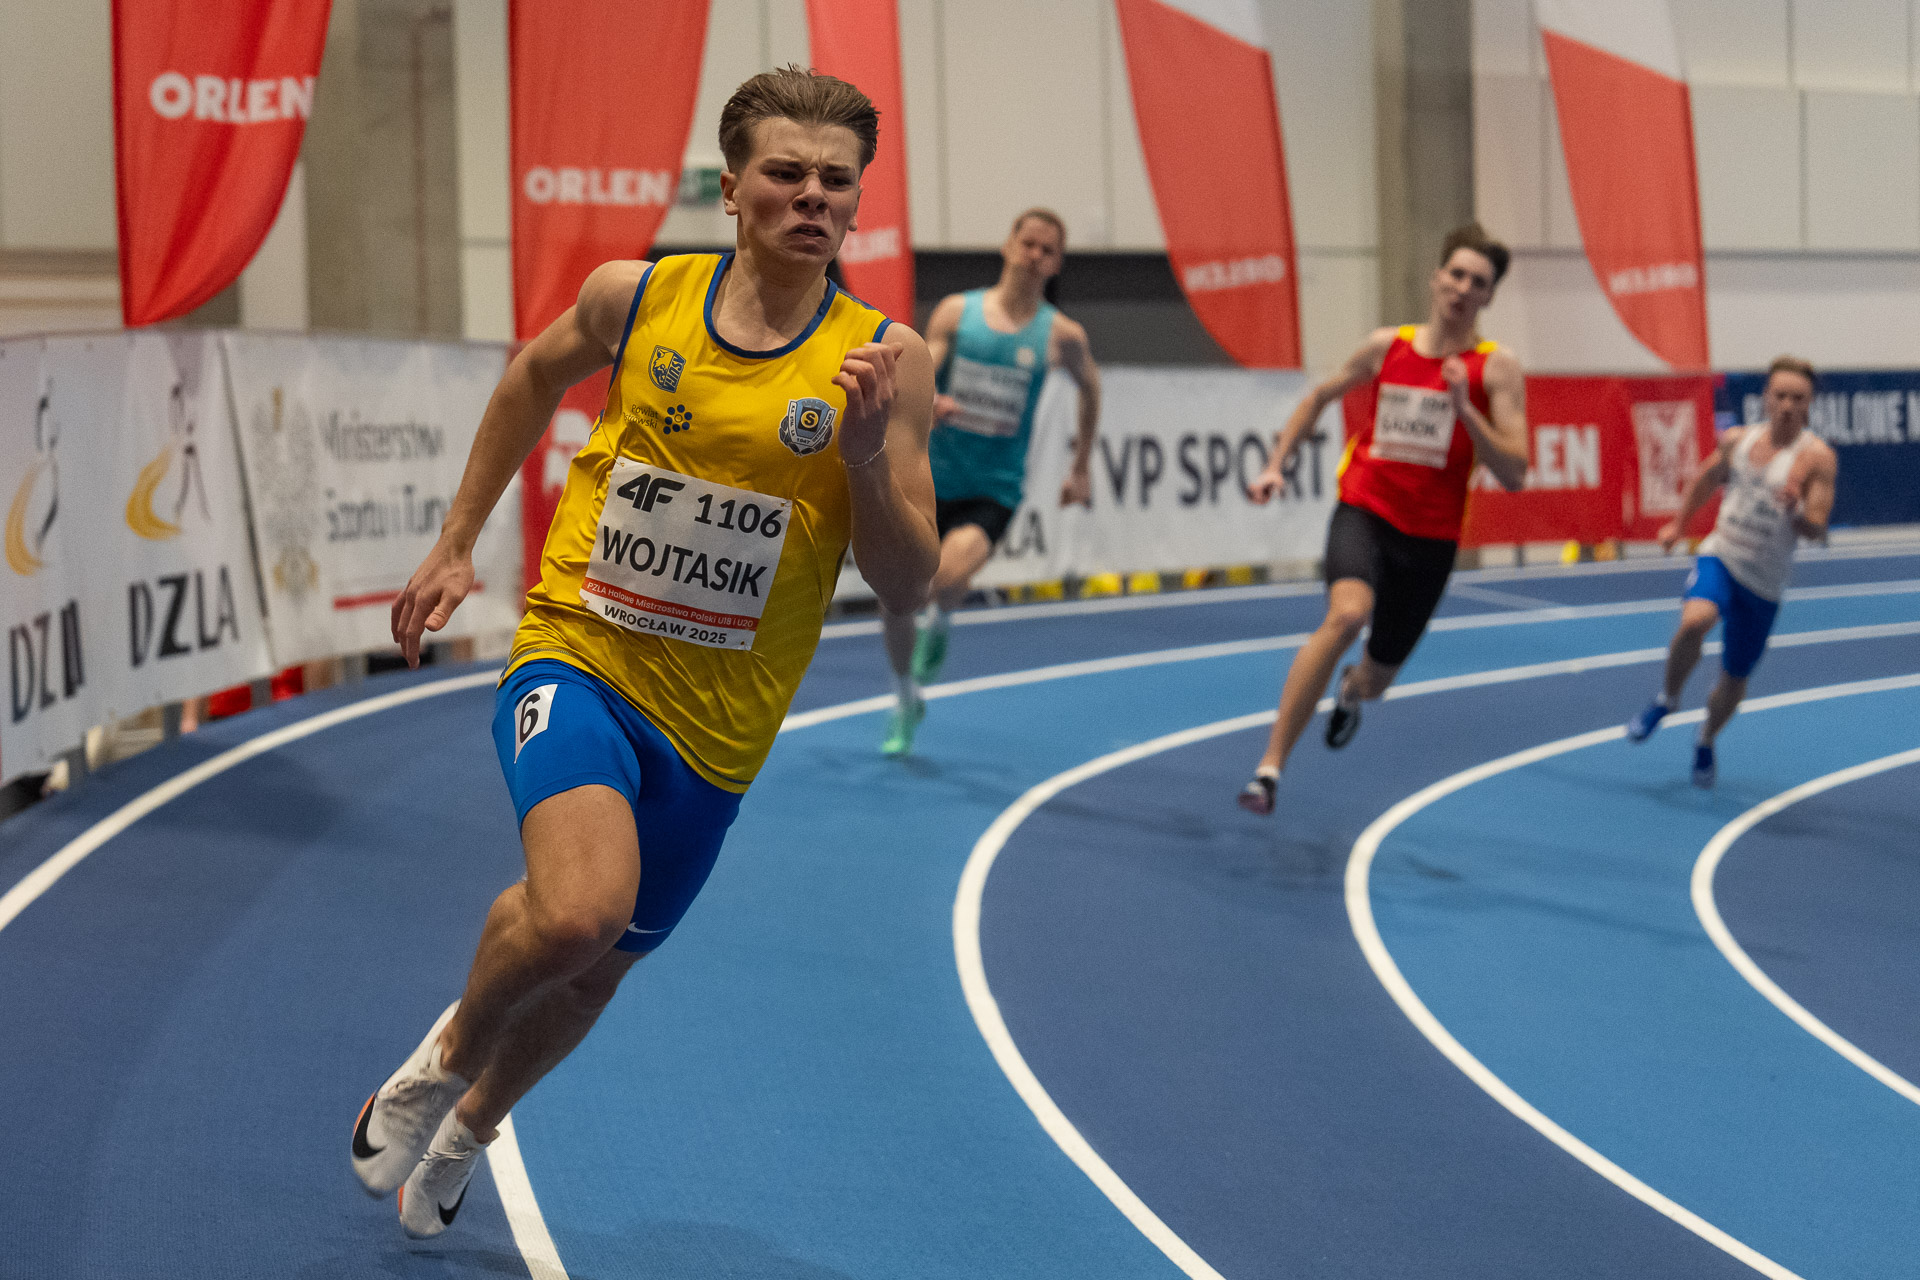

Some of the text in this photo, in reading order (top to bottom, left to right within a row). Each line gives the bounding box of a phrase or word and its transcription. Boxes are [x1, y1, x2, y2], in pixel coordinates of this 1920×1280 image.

[150, 72, 315, 123] ORLEN
[524, 167, 671, 205] ORLEN
[631, 404, 659, 420] Powiat
[804, 412, 816, 426] S
[1071, 434, 1166, 509] VP
[616, 473, 783, 539] 4F 1106
[602, 525, 768, 598] WOJTASIK
[127, 564, 240, 669] DZLA
[586, 581, 607, 595] PZLA
[608, 589, 635, 604] Halowe
[635, 598, 689, 617] Mistrzostwa
[690, 611, 717, 624] Polski
[717, 617, 732, 626] U18
[737, 620, 754, 629] U20
[603, 604, 728, 645] WROCŁAW 2025
[520, 693, 541, 744] 6
